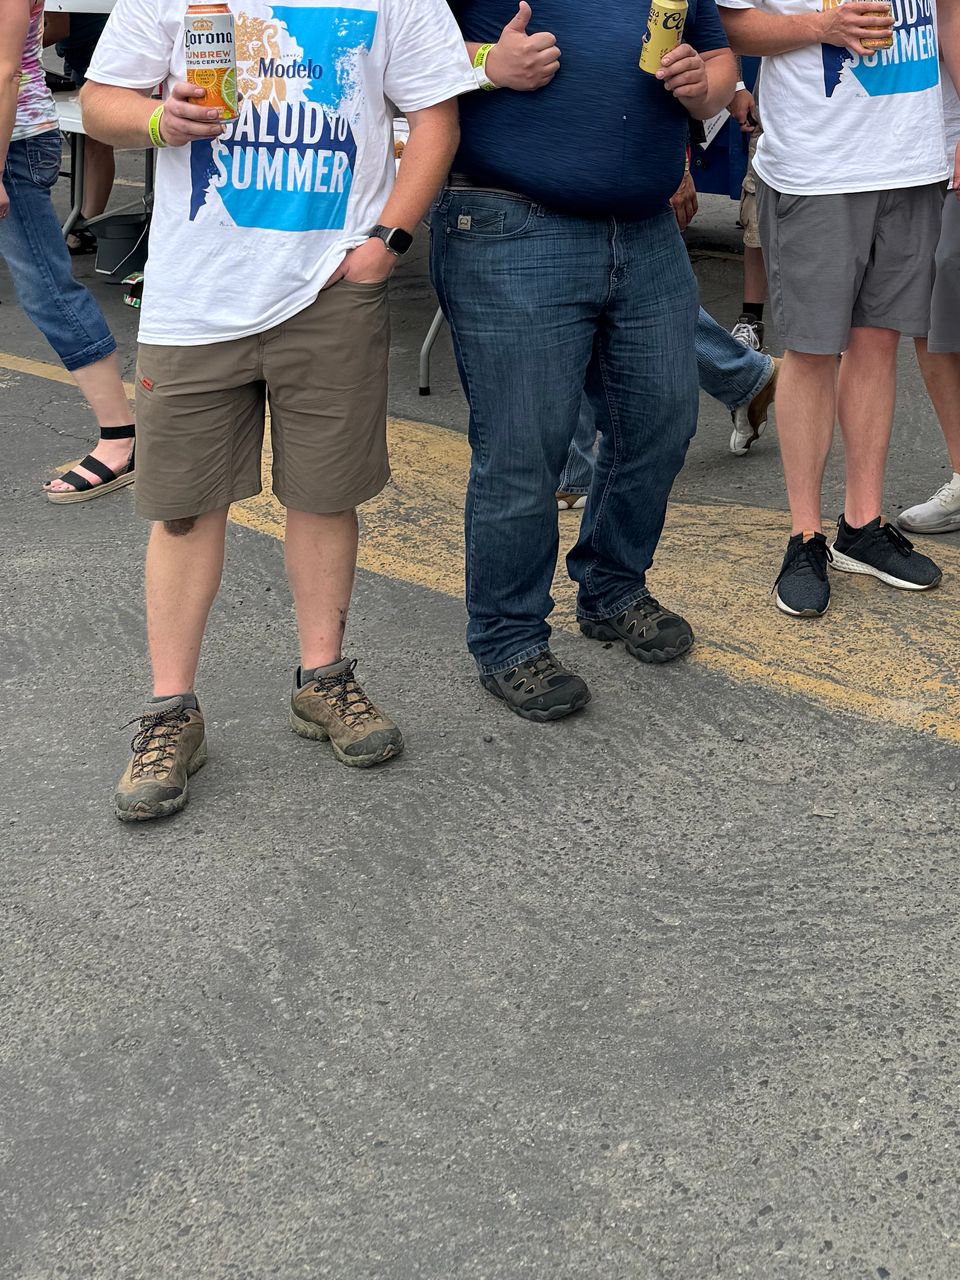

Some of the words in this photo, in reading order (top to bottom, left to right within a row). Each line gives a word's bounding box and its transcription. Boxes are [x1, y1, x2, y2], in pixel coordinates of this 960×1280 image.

[257, 57, 323, 80] Modelo
[326, 114, 348, 141] TO
[212, 138, 348, 193] SUMMER
